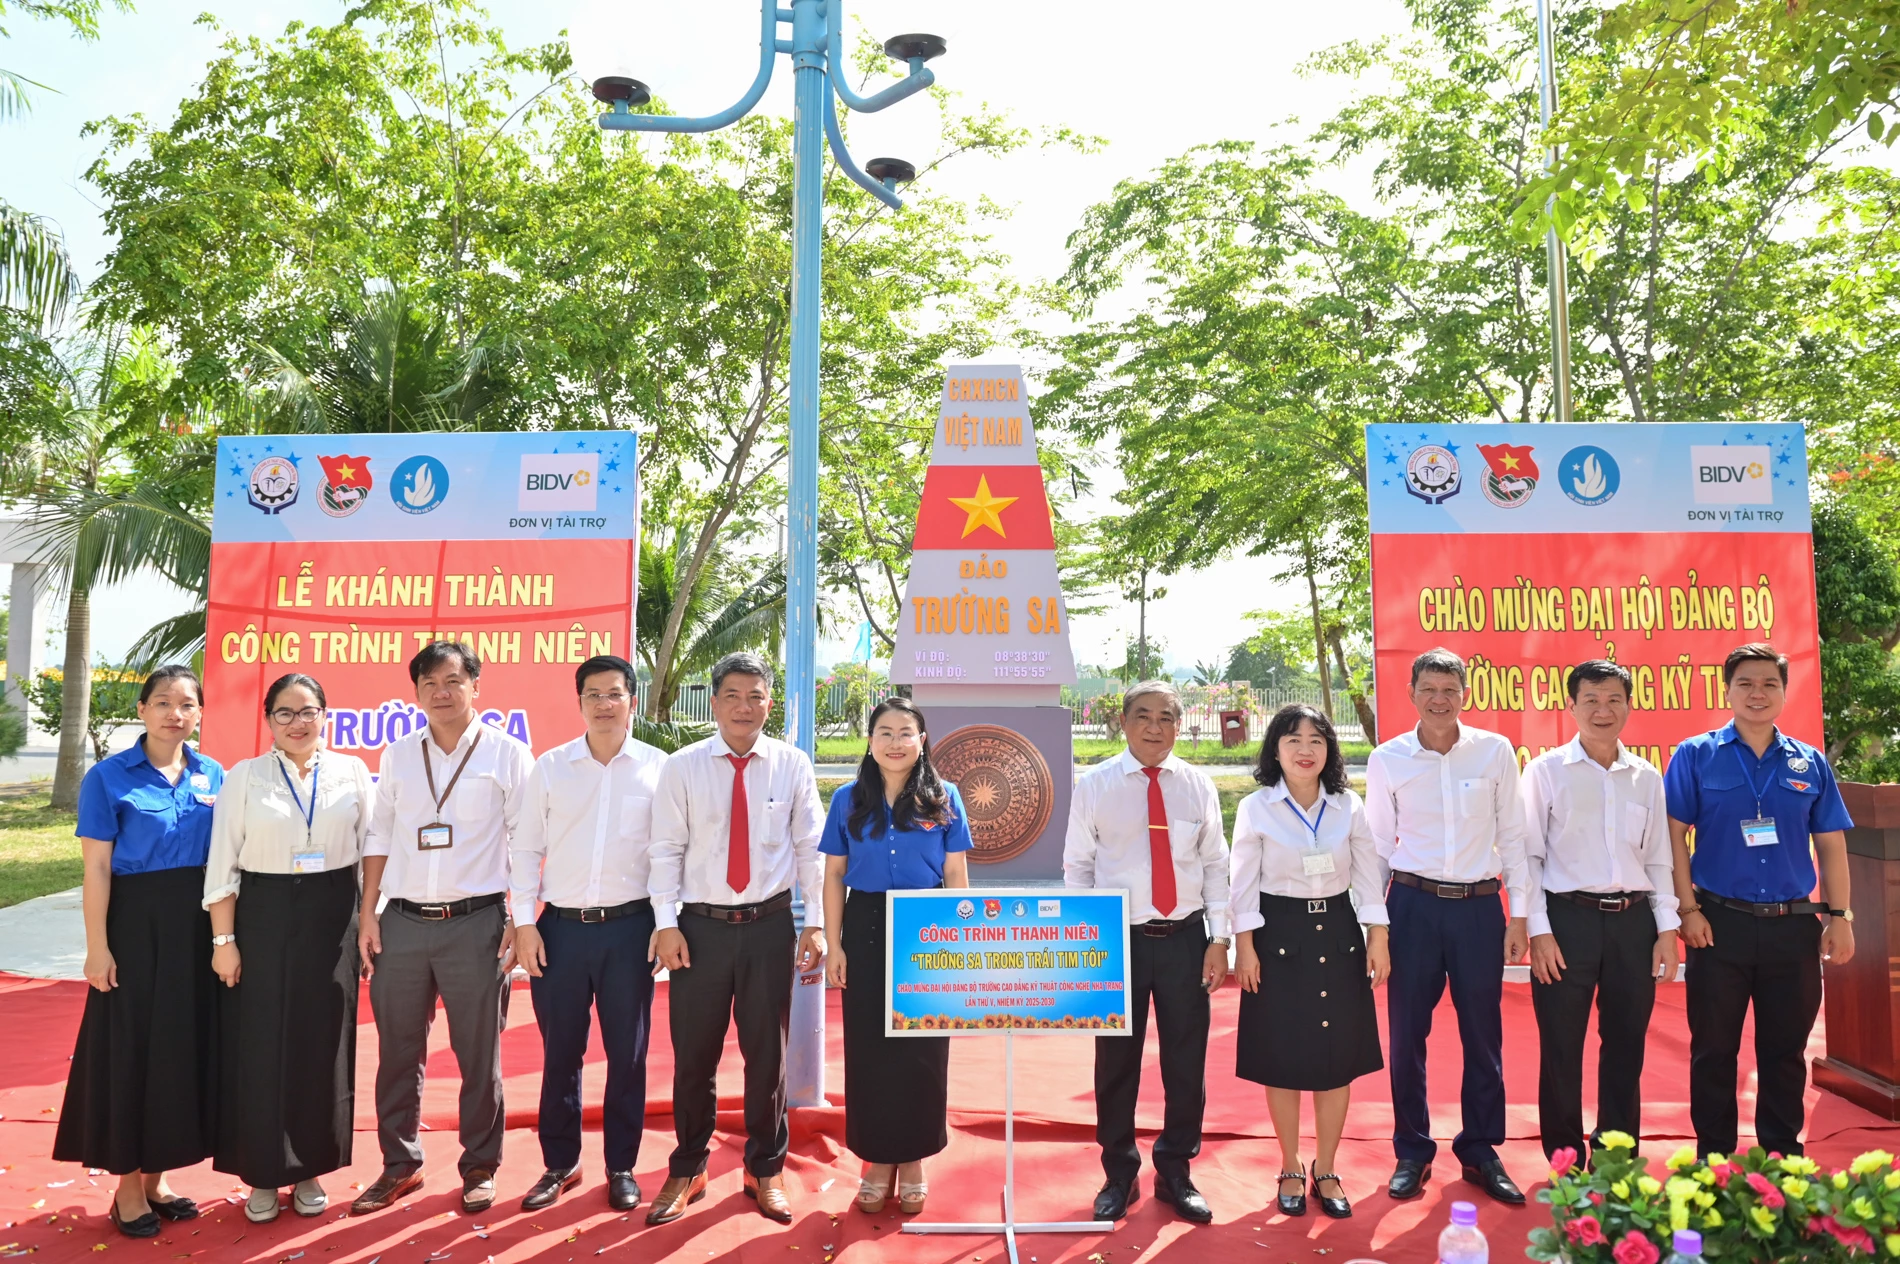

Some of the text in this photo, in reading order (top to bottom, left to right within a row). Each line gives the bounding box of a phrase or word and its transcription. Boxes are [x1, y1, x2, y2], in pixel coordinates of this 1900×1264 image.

[948, 378, 1019, 401] CHXHCN
[944, 411, 1022, 451] VIỆT NAM
[526, 474, 573, 490] BIDV
[1699, 466, 1747, 483] BIDV
[509, 515, 607, 530] ĐƠN VỊ TÀI TRỢ
[1688, 508, 1784, 523] ĐƠN VỊ TÀI TRỢ
[959, 552, 1008, 578] ĐẢO
[277, 560, 554, 607] LỄ KHÁNH THÀNH
[912, 586, 1061, 634] TRƯỜNG SA
[1418, 568, 1774, 640] CHÀO MỪNG ĐẠI HỘI ĐẢNG BỘ
[221, 623, 301, 664] CÔNG
[309, 623, 402, 664] TRÌNH
[533, 622, 612, 664] NIÊN
[915, 666, 943, 677] KINH
[1660, 653, 1693, 710] KỸ
[920, 922, 1099, 942] CÔNG TRÌNH THANH NIÊN
[967, 952, 982, 969] SA
[985, 951, 1024, 969] TRONG
[1026, 947, 1054, 969] TRÁI
[1057, 951, 1079, 968] TIM
[898, 982, 913, 993] CHÀO
[914, 982, 930, 992] MỪNG
[931, 984, 940, 994] ĐẠI
[942, 982, 952, 993] HỘI
[953, 980, 968, 992] ĐẢNG
[969, 981, 977, 993] BỘ
[979, 981, 1000, 992] TRƯỜNG
[1002, 982, 1013, 992] CAO
[1040, 981, 1058, 992] THUẬT
[1060, 980, 1074, 991] CÔNG
[1076, 979, 1090, 993] NGHỆ
[1092, 981, 1104, 991] NHA
[1105, 981, 1123, 991] TRANG
[965, 996, 976, 1007] LẦN
[977, 996, 989, 1007] THỨ
[997, 996, 1015, 1007] NHIỆM
[1026, 997, 1055, 1007] 2025-2030
